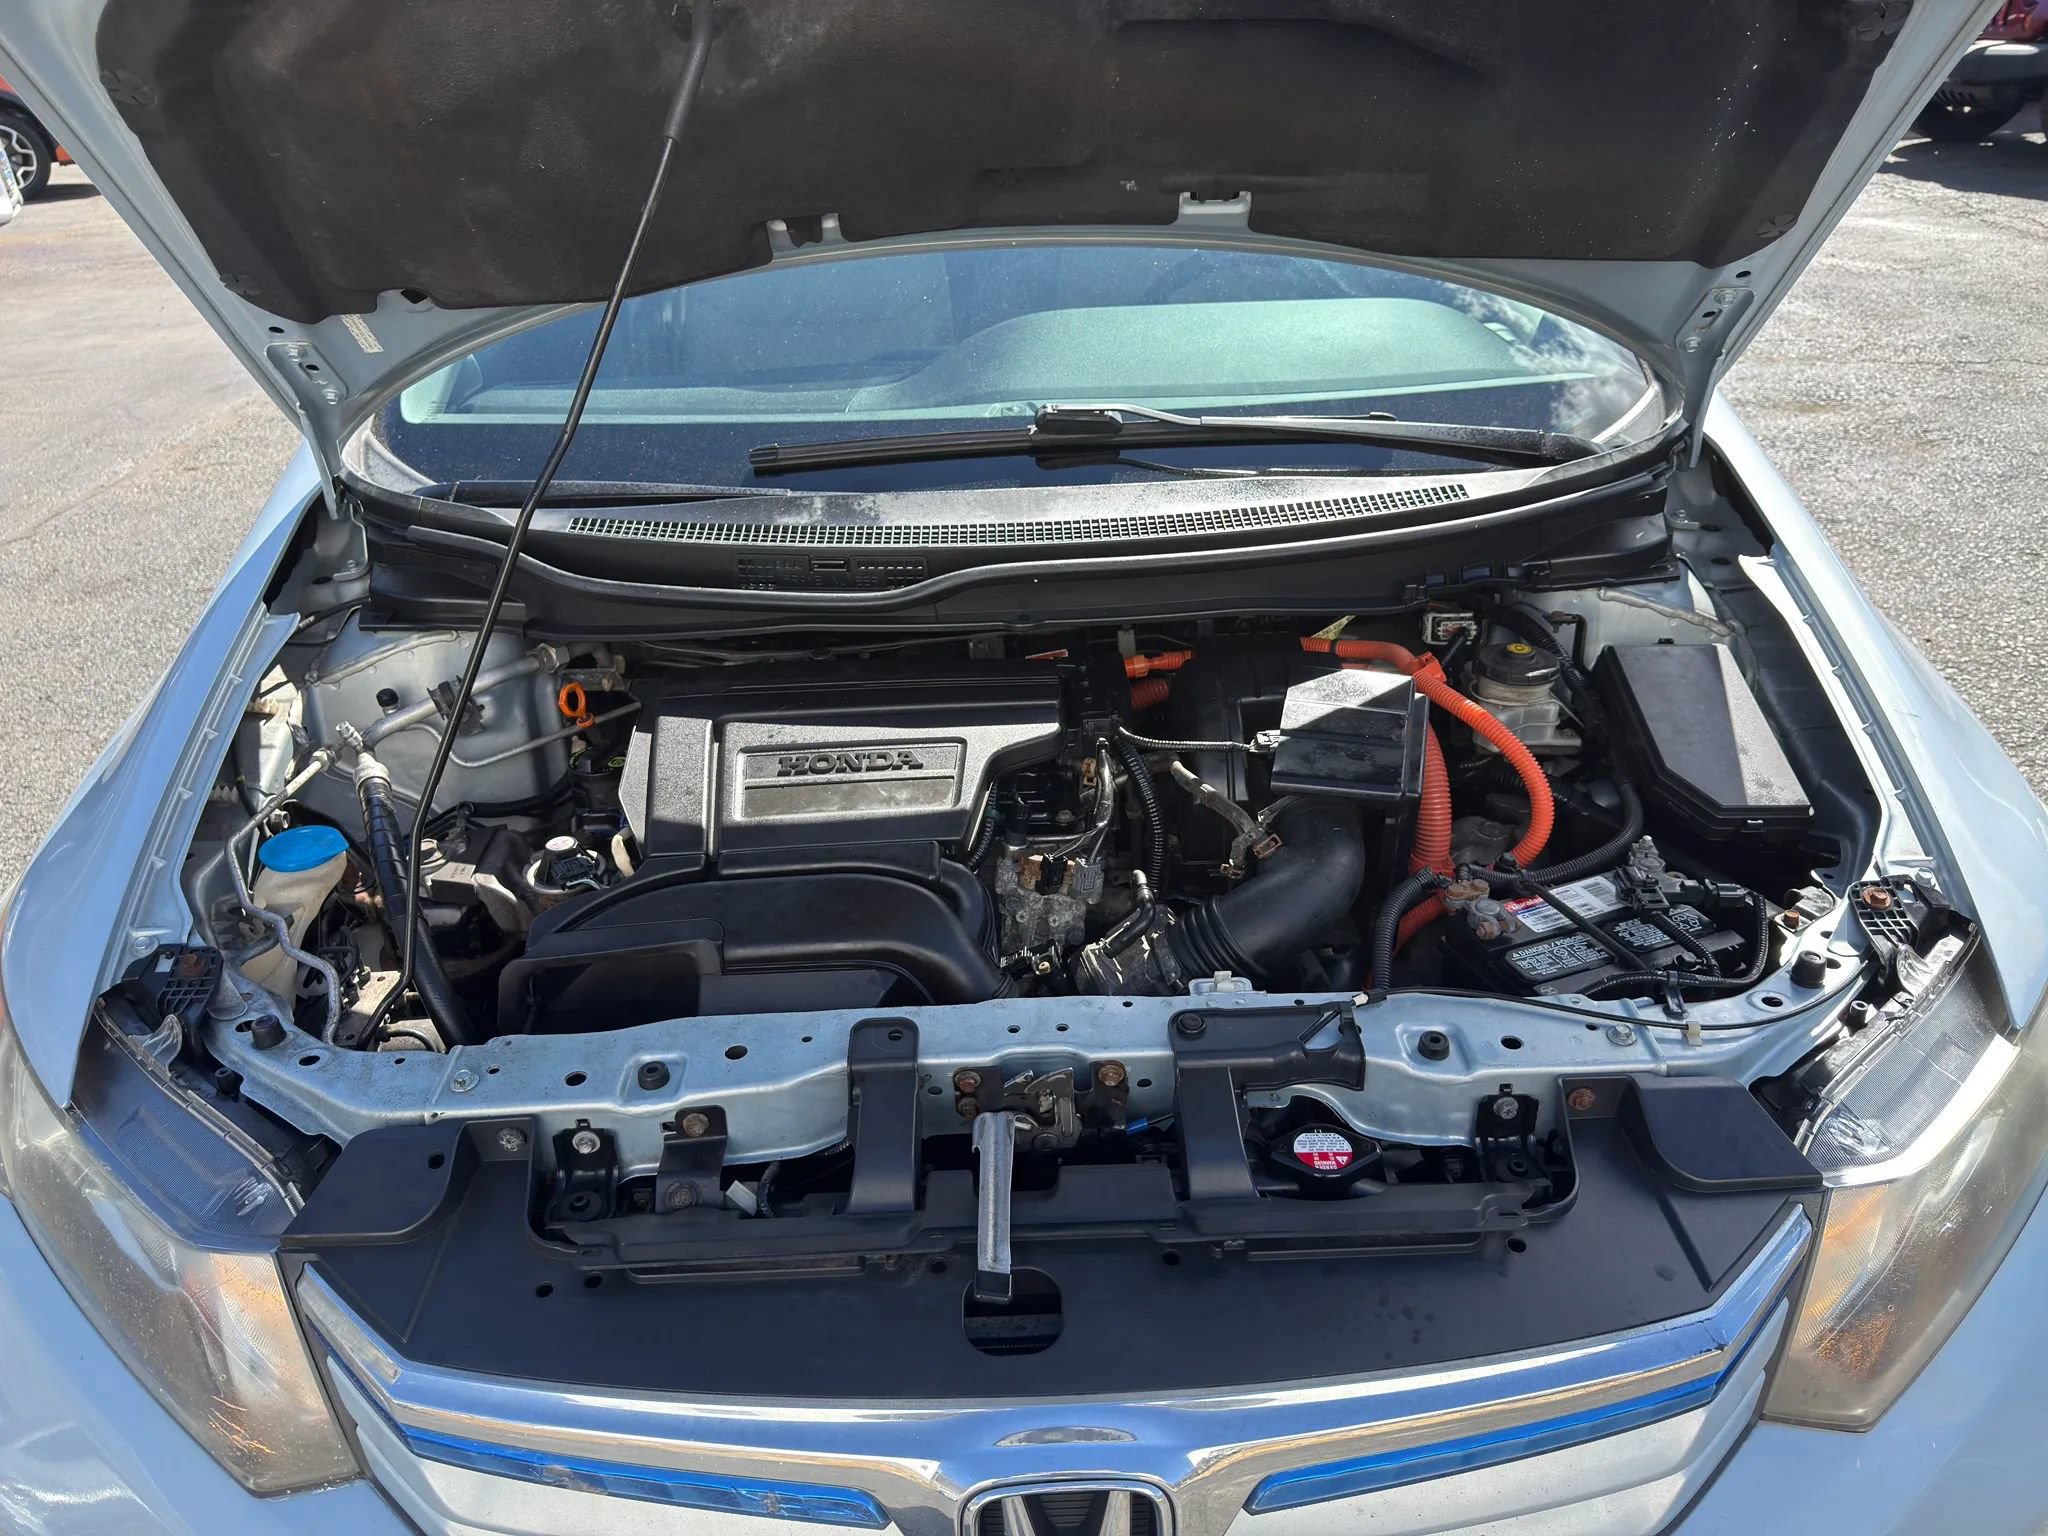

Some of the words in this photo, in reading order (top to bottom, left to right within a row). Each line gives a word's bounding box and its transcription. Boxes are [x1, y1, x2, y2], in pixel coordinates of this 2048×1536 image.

[777, 750, 924, 777] HONDA
[1518, 943, 1550, 956] DANGER
[1555, 935, 1584, 946] POISON
